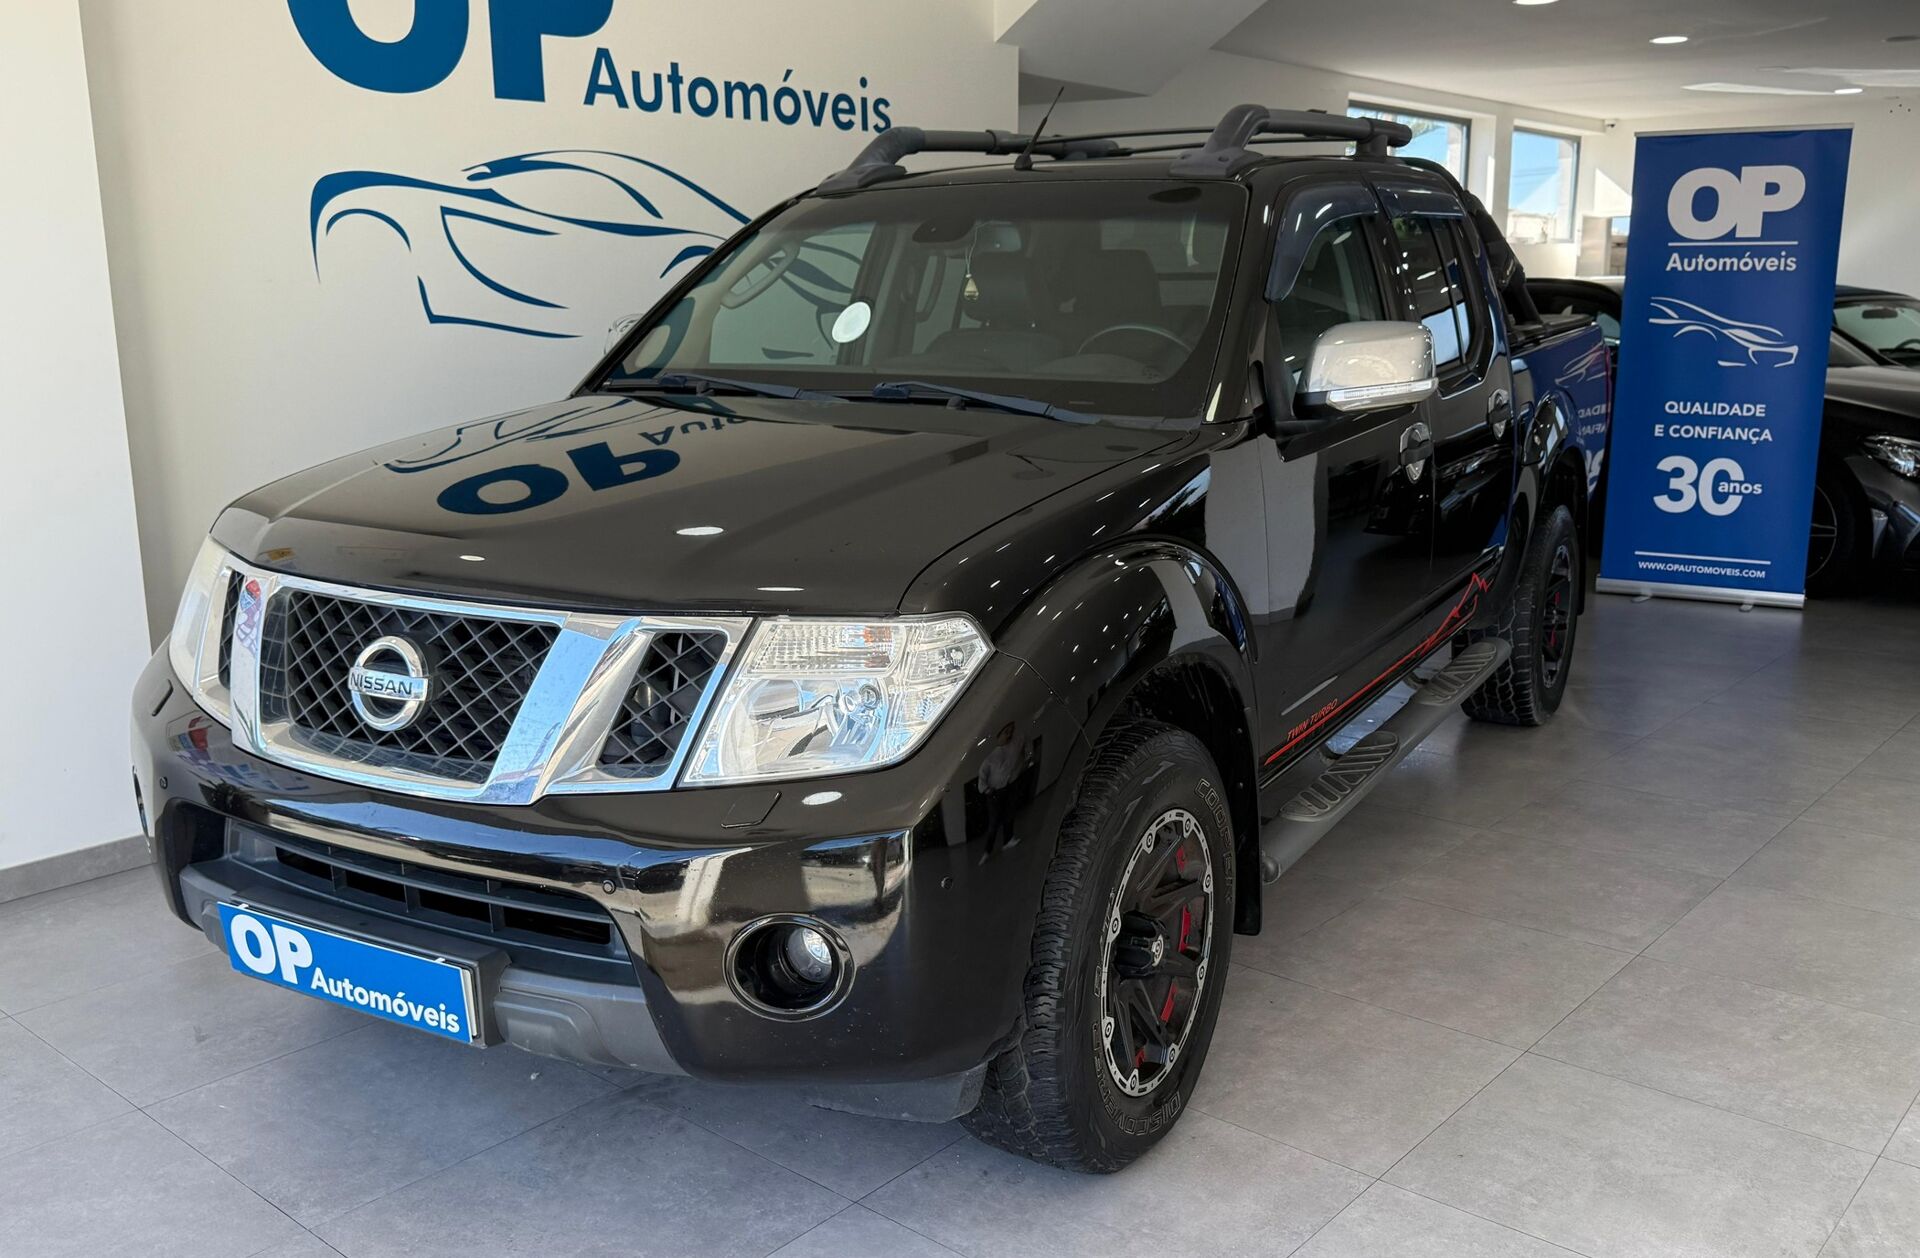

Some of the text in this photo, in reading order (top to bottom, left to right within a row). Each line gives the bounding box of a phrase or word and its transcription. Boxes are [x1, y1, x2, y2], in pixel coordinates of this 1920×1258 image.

[583, 46, 892, 135] Automóveis
[1667, 165, 1806, 241] OP
[1665, 251, 1798, 272] Automóveis
[1664, 401, 1767, 417] QUALIDADE
[1654, 424, 1773, 444] E CONFIANÇA
[1653, 455, 1763, 517] 30 anos
[1638, 561, 1767, 579] WWW.OPAUTOMOVEIS.COM
[350, 671, 413, 695] NISSAN
[1287, 698, 1338, 742] TWIN TURBO
[230, 913, 313, 985] OP
[310, 967, 460, 1034] Automóveis
